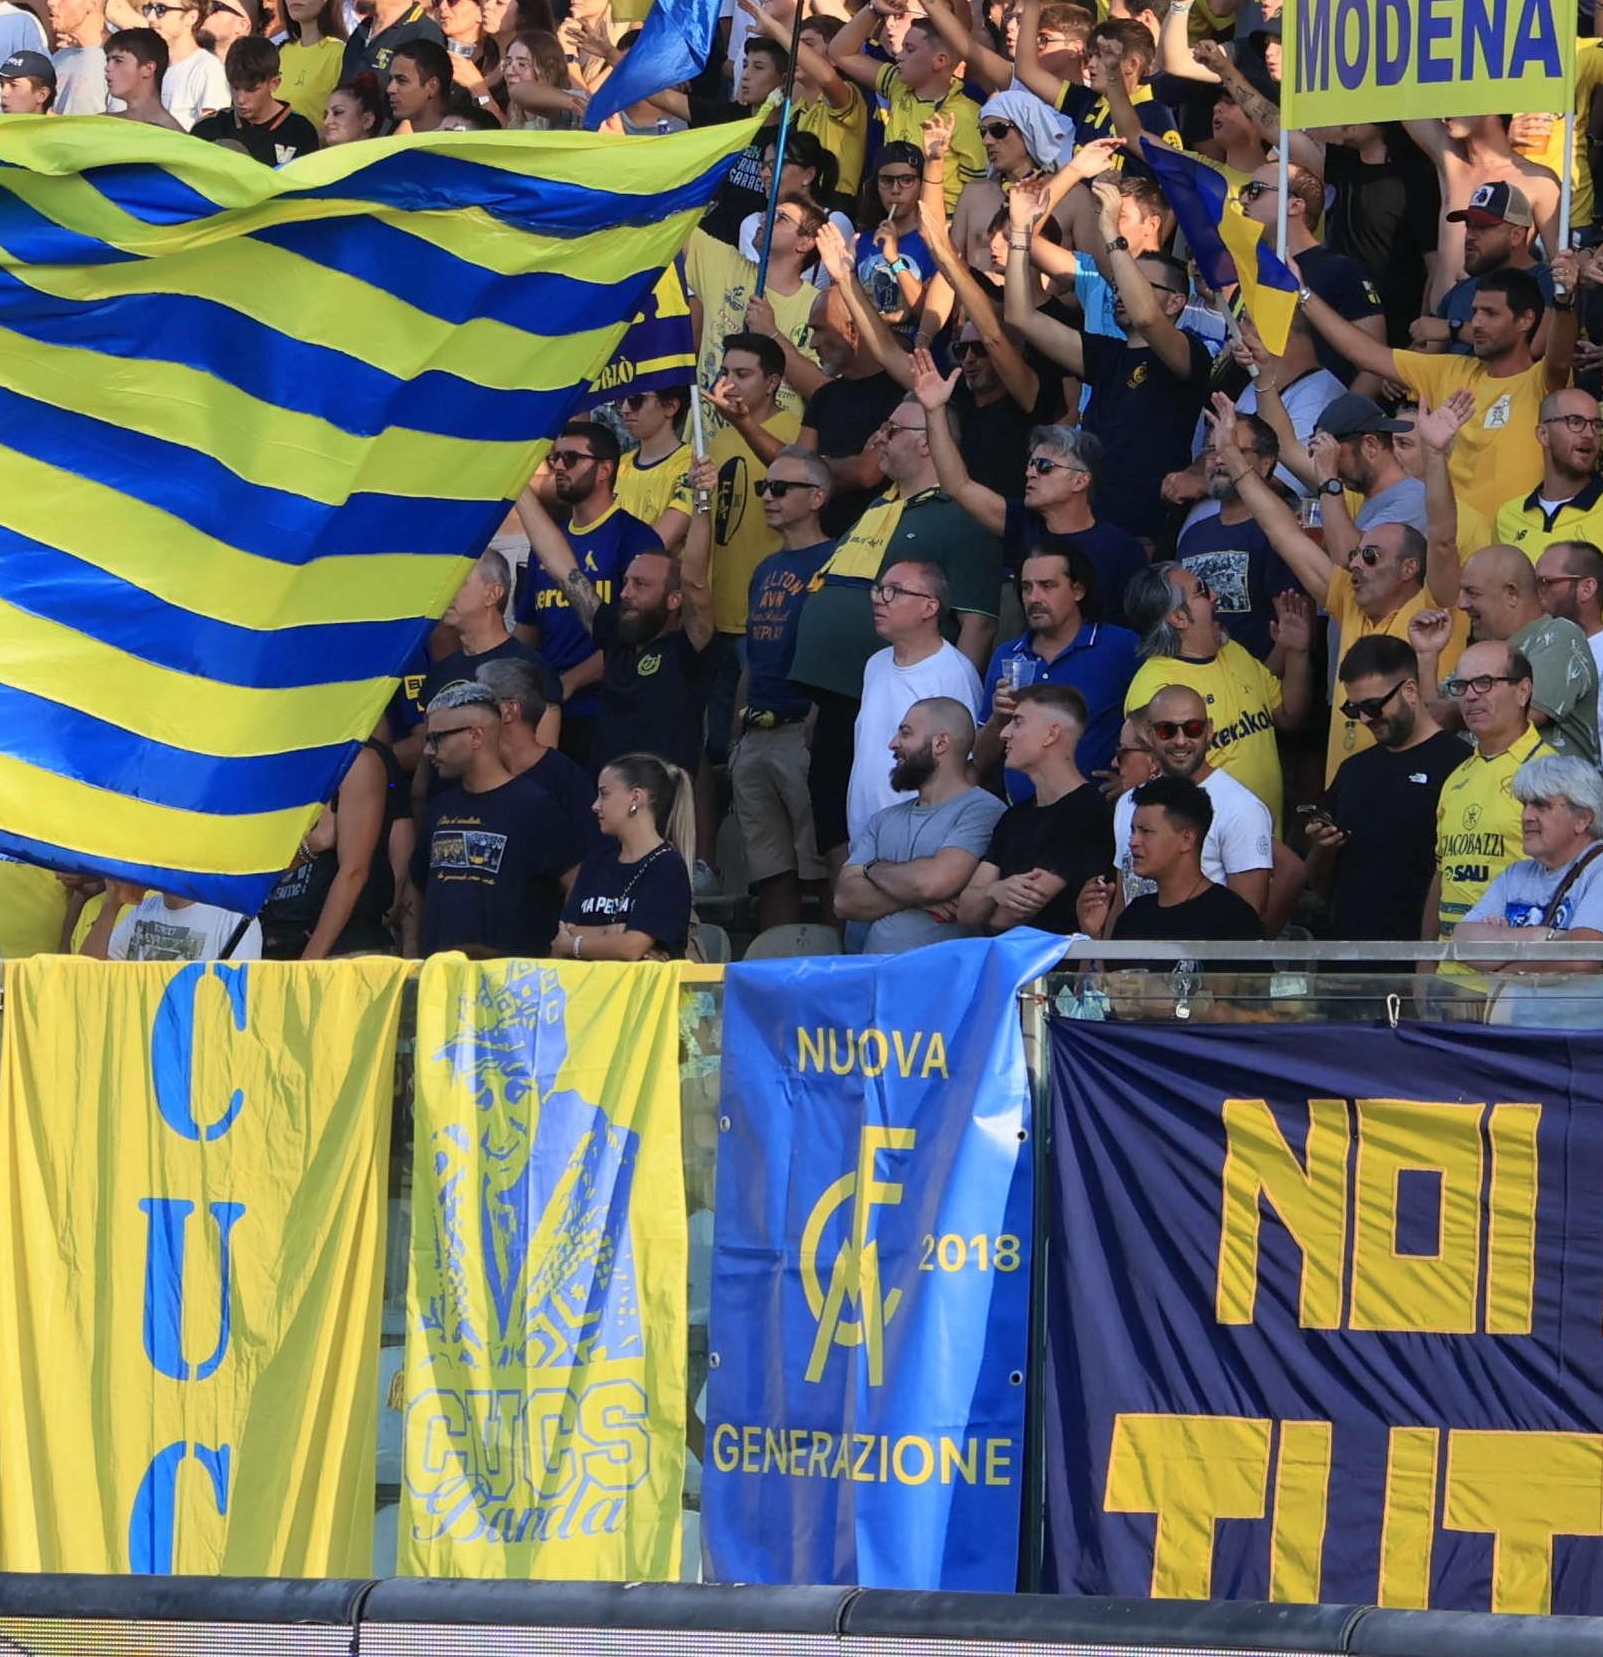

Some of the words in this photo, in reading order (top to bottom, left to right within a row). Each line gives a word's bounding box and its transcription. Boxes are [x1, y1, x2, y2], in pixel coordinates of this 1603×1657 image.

[796, 1026, 950, 1081] NUOVA
[918, 1232, 1023, 1273] 2018
[1215, 1098, 1542, 1334] NOI
[404, 1378, 650, 1501] CUCS
[711, 1423, 1013, 1488] GENERAZIONE
[410, 1463, 627, 1544] Banda
